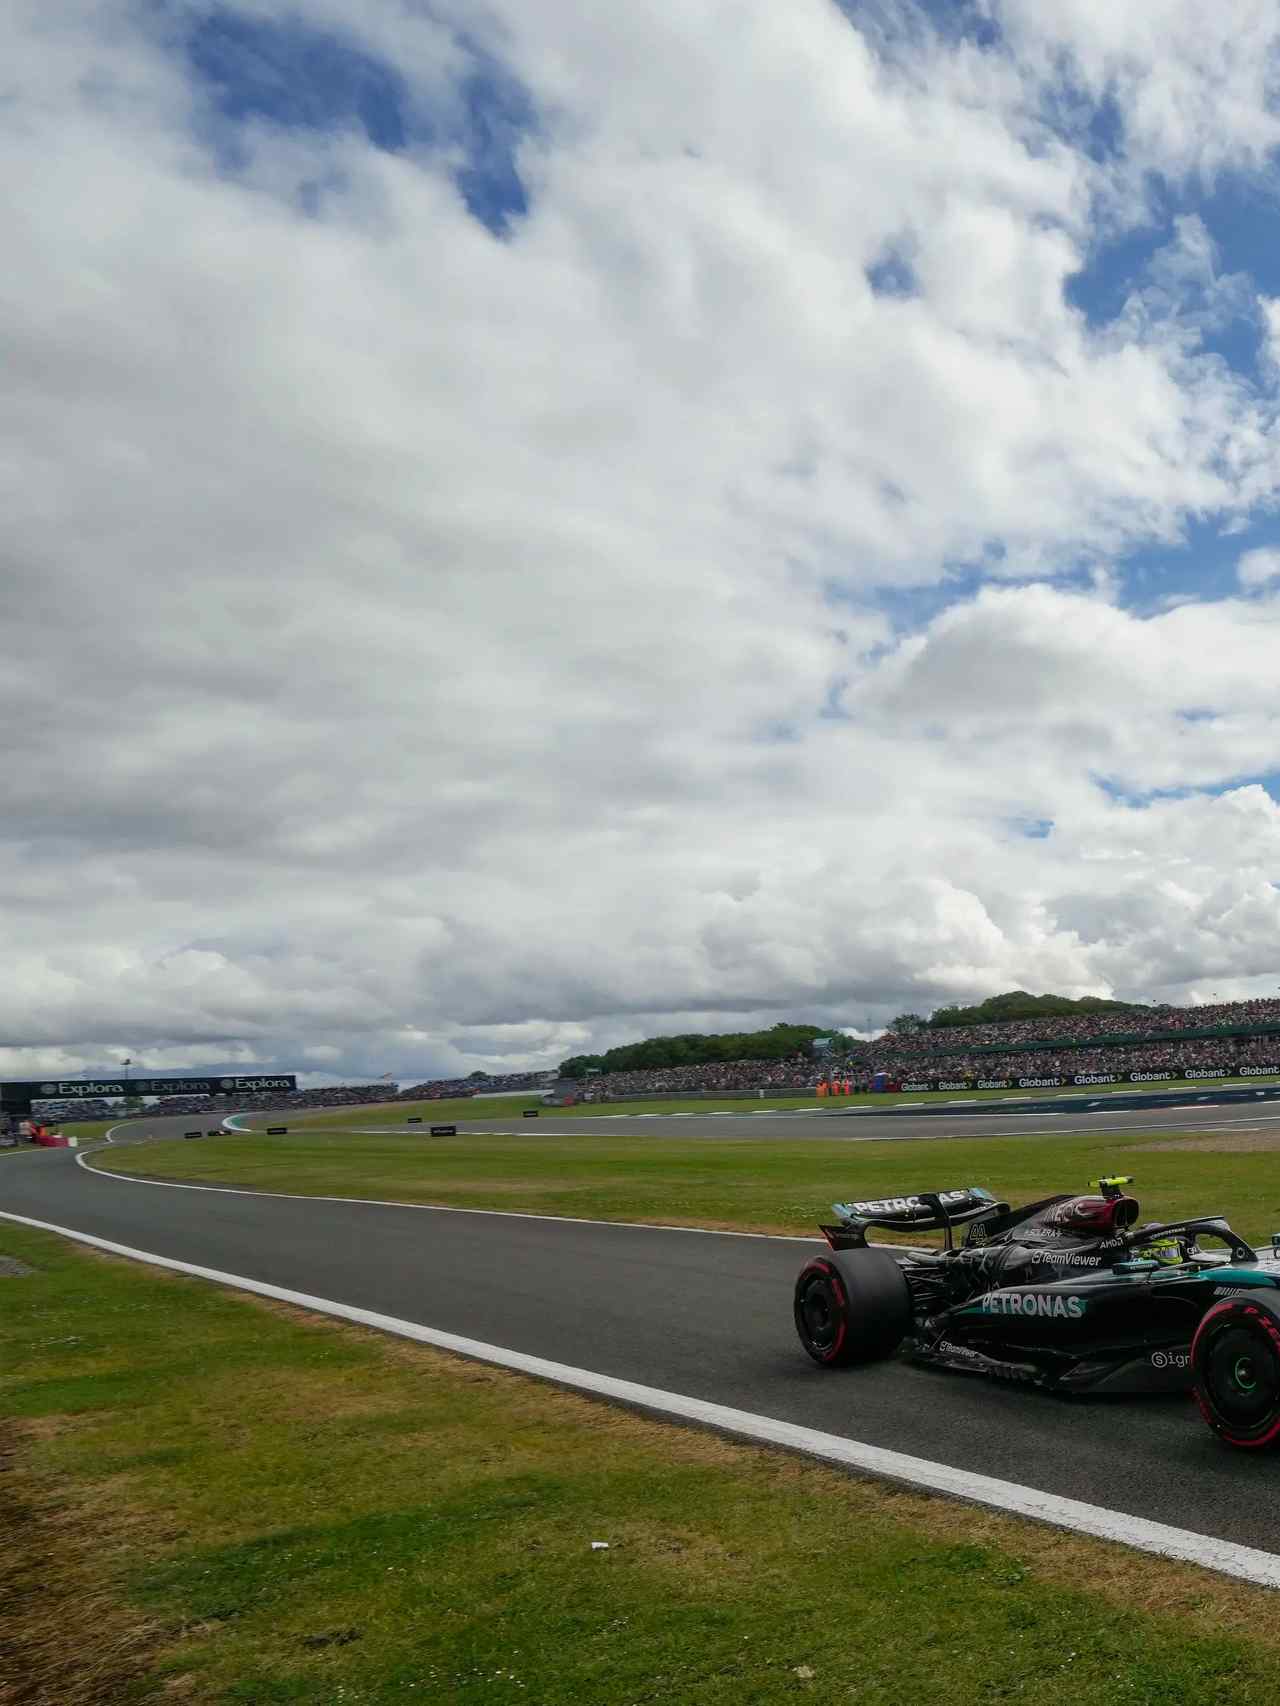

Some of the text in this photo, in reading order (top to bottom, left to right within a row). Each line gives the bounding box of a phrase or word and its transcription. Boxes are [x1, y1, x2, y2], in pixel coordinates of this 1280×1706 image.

[1185, 1069, 1226, 1079] Globant
[1239, 1065, 1279, 1076] Globant
[1019, 1077, 1060, 1087] Globant
[1074, 1074, 1116, 1085] Globant
[1130, 1071, 1171, 1082] Globant
[59, 1083, 124, 1096] Explora
[235, 1078, 290, 1090] Explora
[853, 1190, 966, 1212] PETROAS
[1100, 1239, 1120, 1250] AMD
[1041, 1253, 1102, 1267] TeamViewer
[982, 1293, 1083, 1318] PETRONAS
